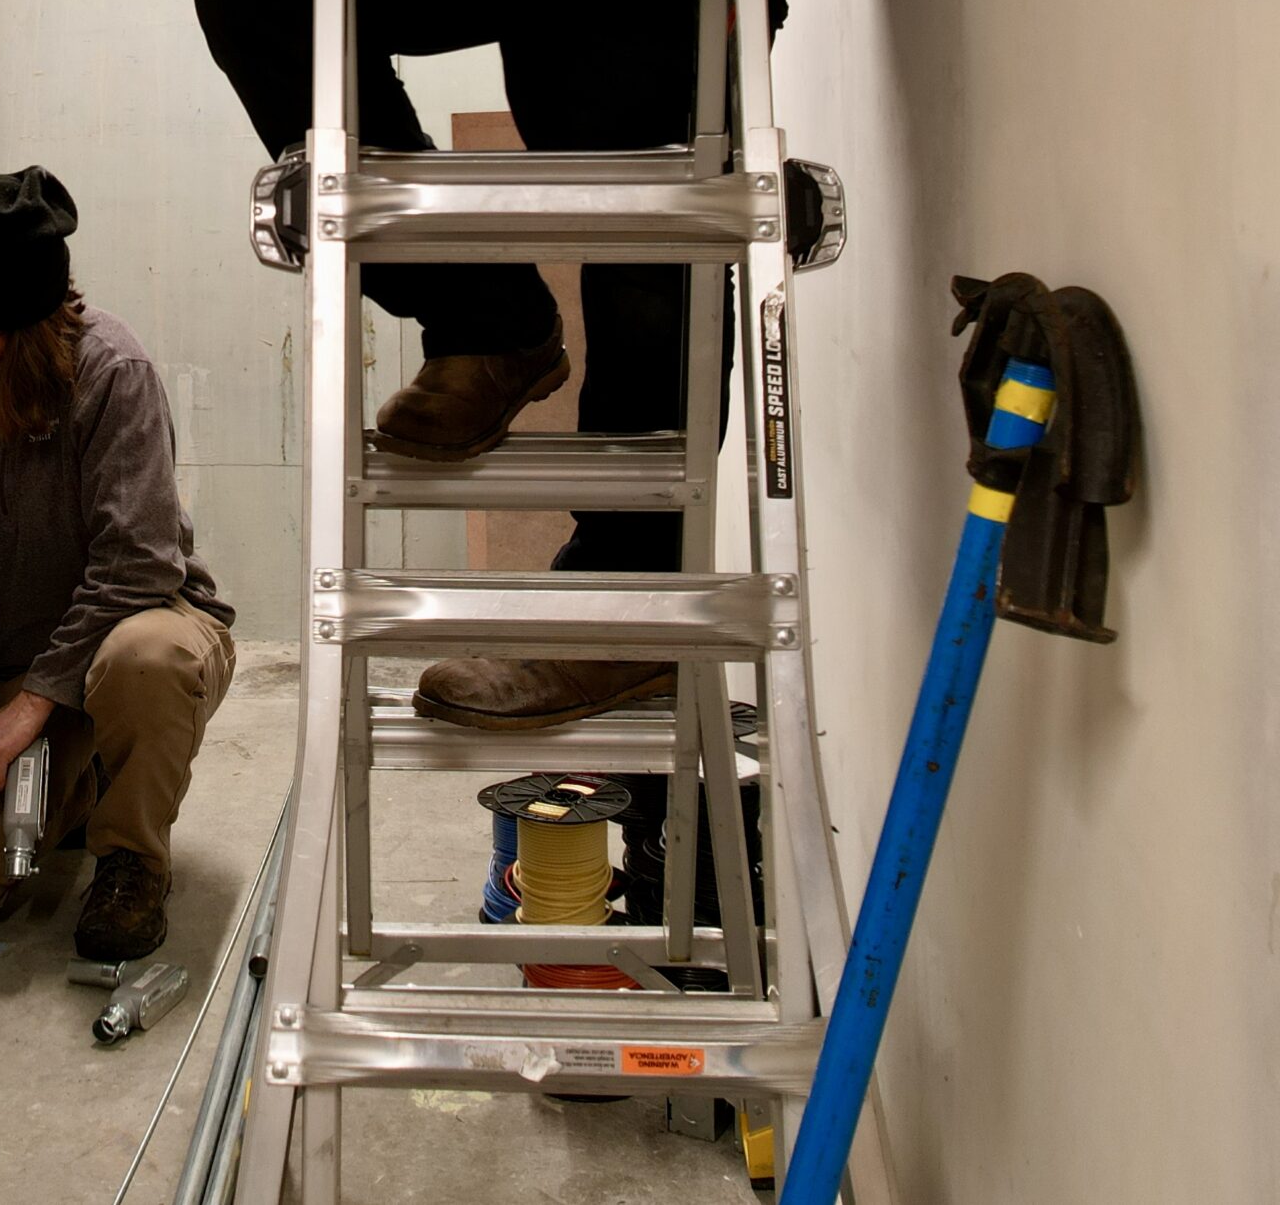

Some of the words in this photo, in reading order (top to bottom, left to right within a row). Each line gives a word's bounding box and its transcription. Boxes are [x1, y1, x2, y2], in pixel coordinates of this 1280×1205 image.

[767, 364, 784, 418] SPEED
[776, 420, 786, 468] ALUMINUM
[777, 467, 787, 490] CAST
[628, 1052, 688, 1061] ADVERTENCIA
[637, 1060, 680, 1069] WARNING
